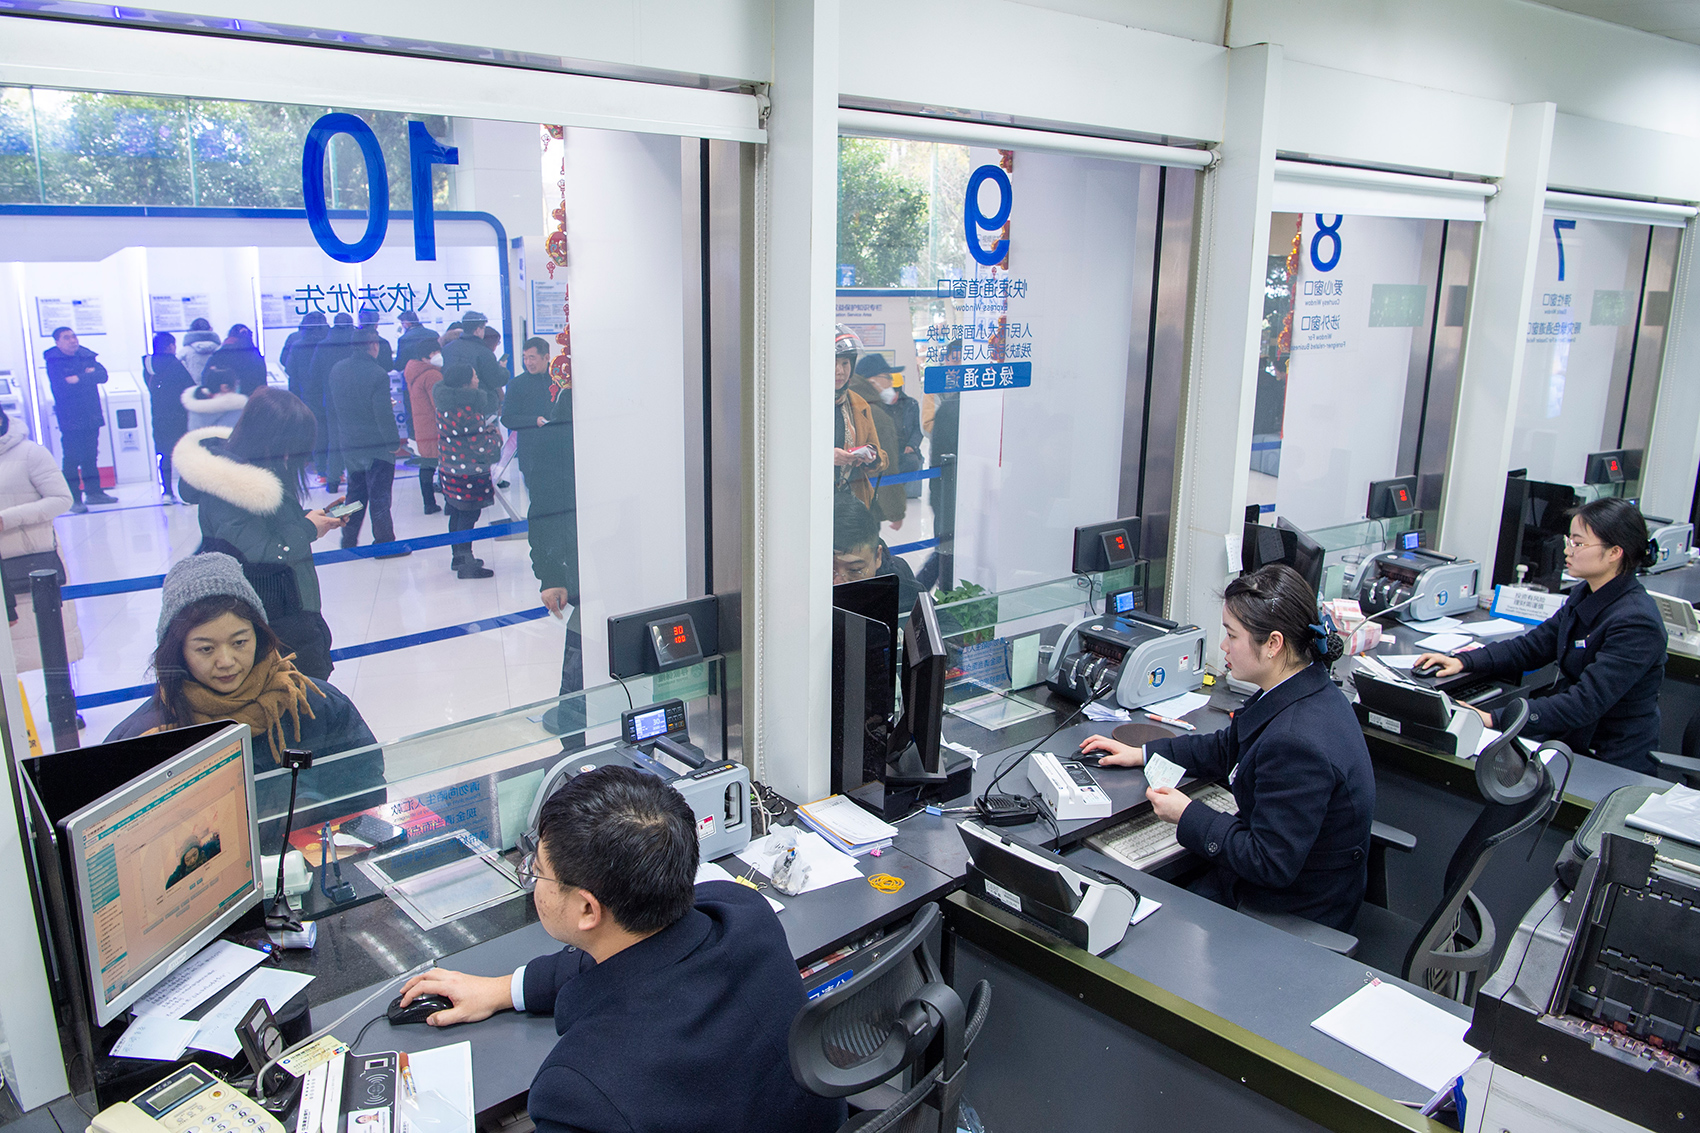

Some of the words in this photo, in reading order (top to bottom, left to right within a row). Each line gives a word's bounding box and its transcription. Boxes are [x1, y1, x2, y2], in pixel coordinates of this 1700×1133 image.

[673, 625, 684, 636] 30
[674, 634, 686, 644] 100
[216, 1124, 226, 1132] 5
